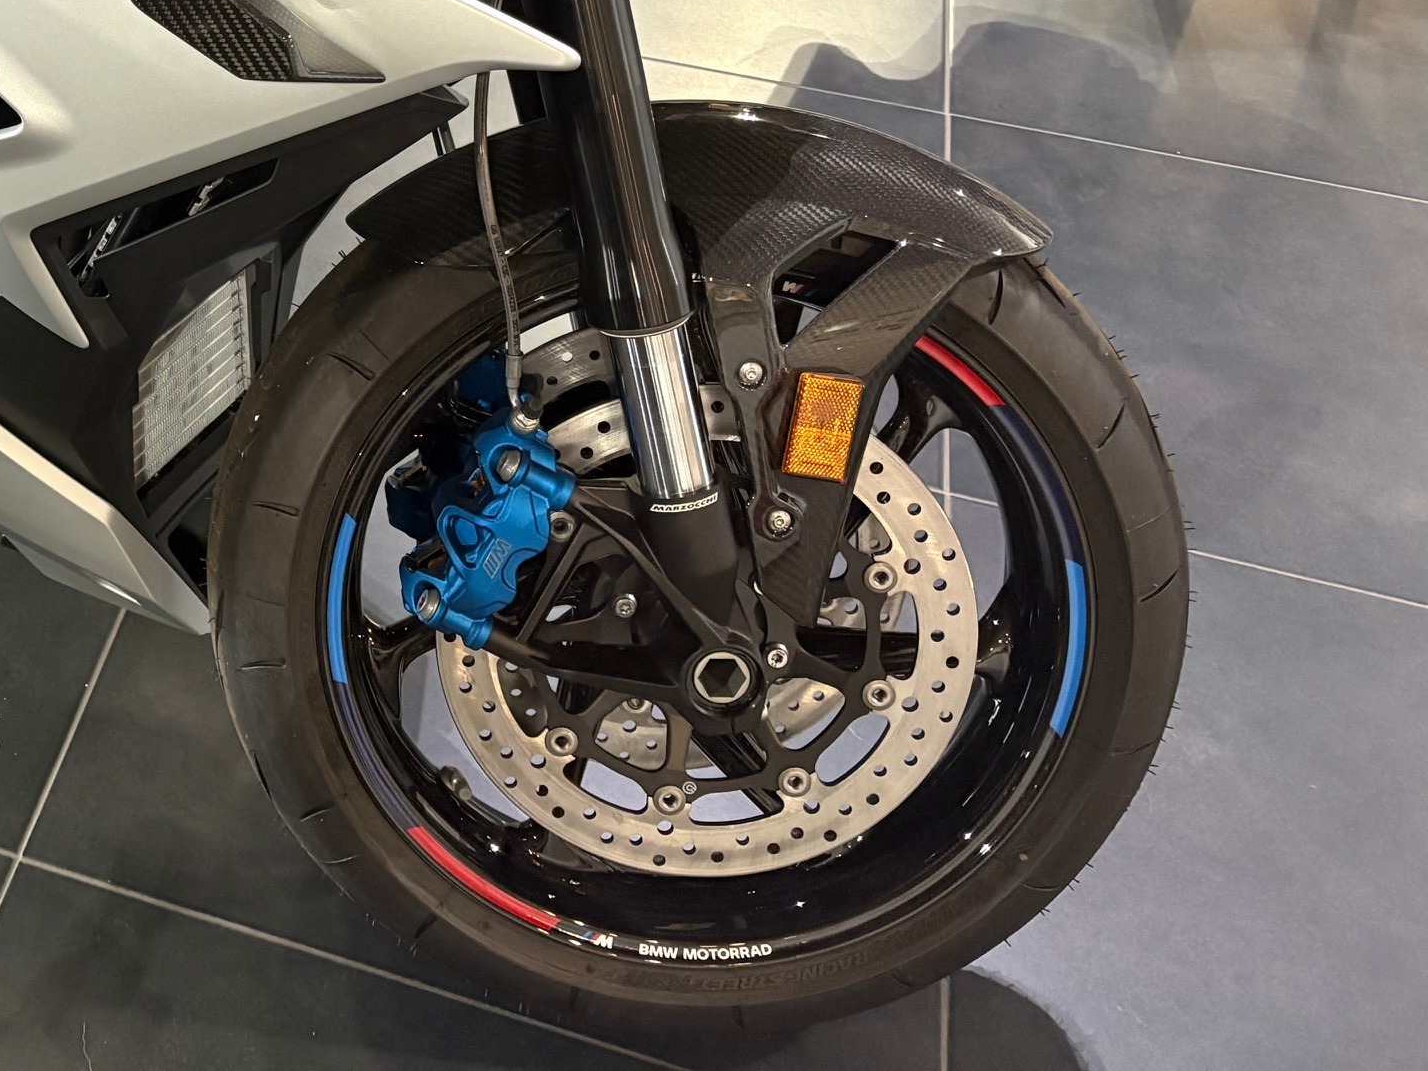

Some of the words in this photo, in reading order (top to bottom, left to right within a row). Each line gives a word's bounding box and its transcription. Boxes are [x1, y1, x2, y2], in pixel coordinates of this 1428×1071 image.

[651, 494, 718, 511] MARZOCCHI
[638, 942, 679, 960] BMW
[682, 942, 773, 961] MOTORRAD
